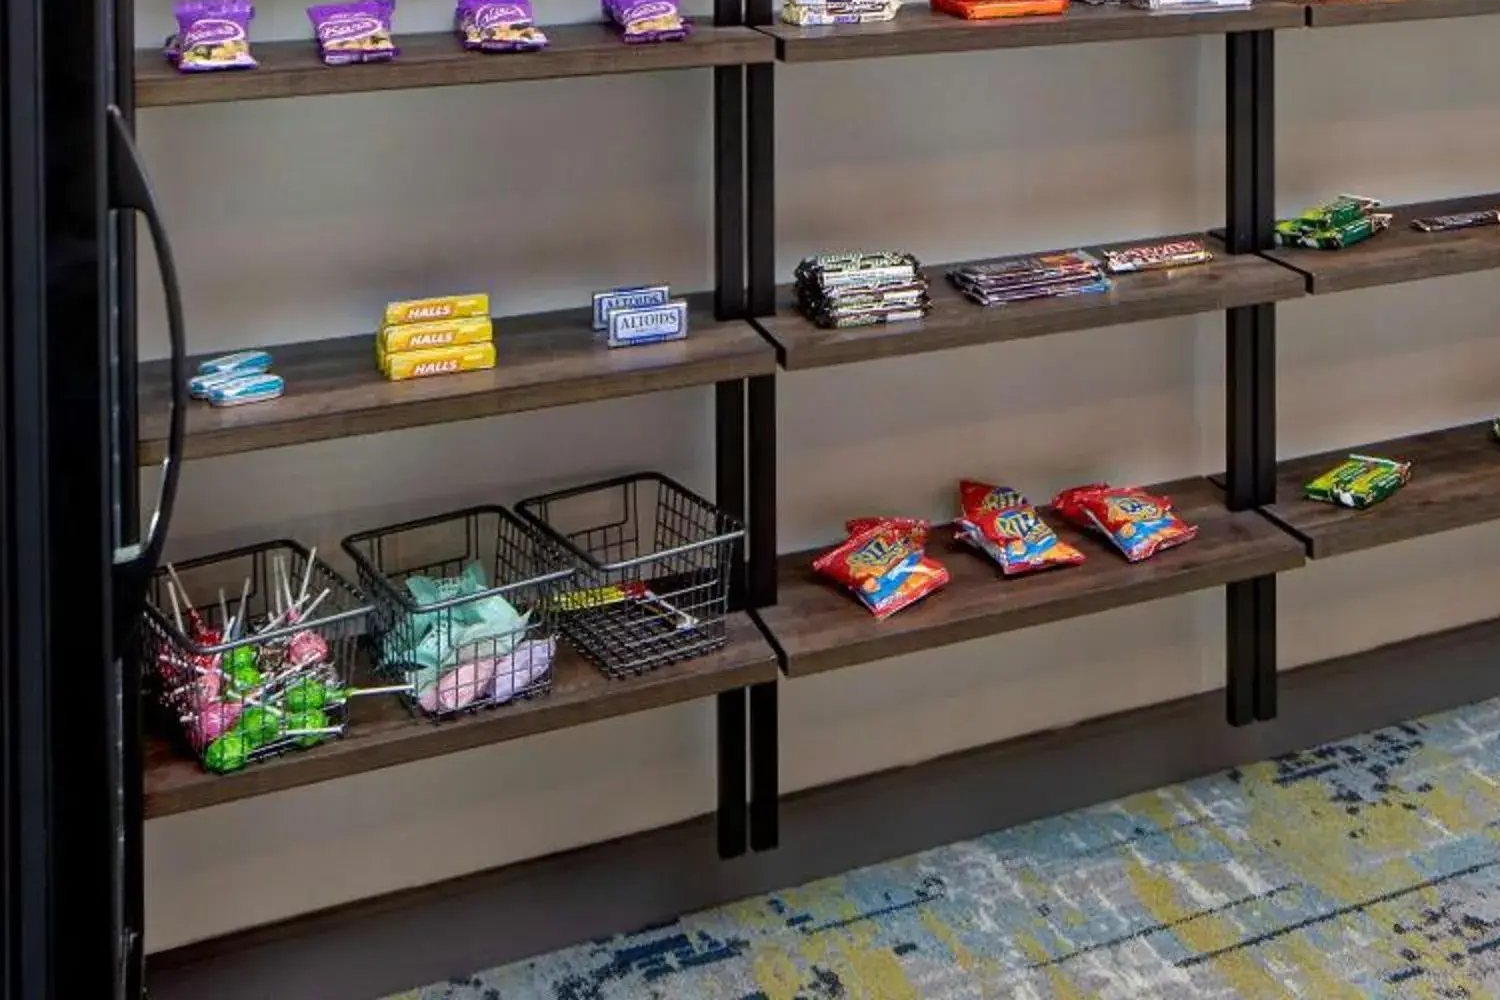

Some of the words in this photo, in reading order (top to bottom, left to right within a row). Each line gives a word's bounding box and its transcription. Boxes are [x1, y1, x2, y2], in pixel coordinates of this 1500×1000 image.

[408, 305, 452, 318] HALLS
[620, 311, 677, 330] ALTOIDS
[410, 332, 453, 345] HALLS
[415, 359, 458, 374] HALLS
